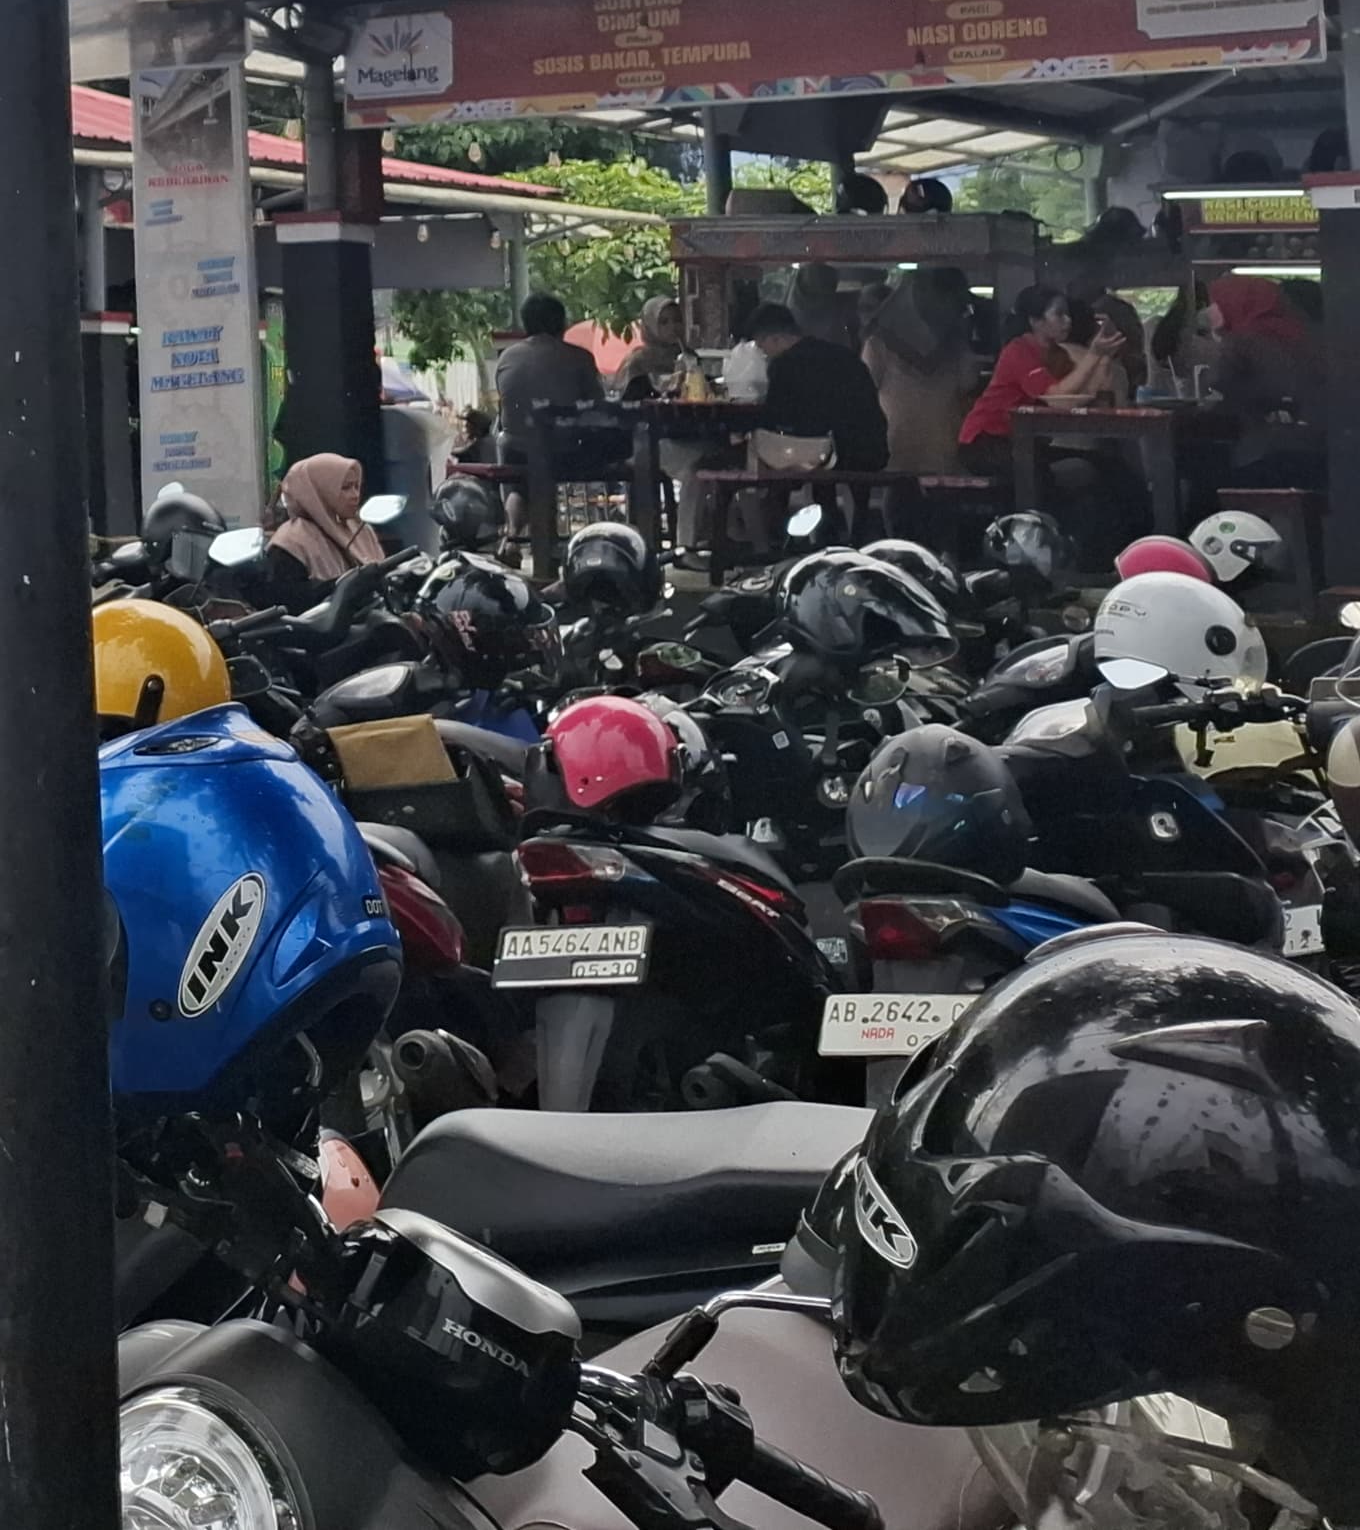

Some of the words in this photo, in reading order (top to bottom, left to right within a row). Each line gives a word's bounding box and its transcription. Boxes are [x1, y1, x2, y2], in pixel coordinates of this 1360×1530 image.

[907, 23, 955, 46] NASI
[962, 17, 1047, 41] GORENG
[533, 55, 584, 75] SOSIS
[590, 50, 655, 70] BAKAR,
[661, 41, 751, 66] TEMPURA
[357, 64, 438, 87] Magelang
[186, 882, 256, 1005] INK
[506, 935, 534, 956] AA
[539, 932, 590, 955] 5464
[599, 930, 641, 952] ANB
[829, 1002, 857, 1023] AB
[861, 1027, 895, 1039] NADA
[442, 1318, 529, 1377] HONDA
